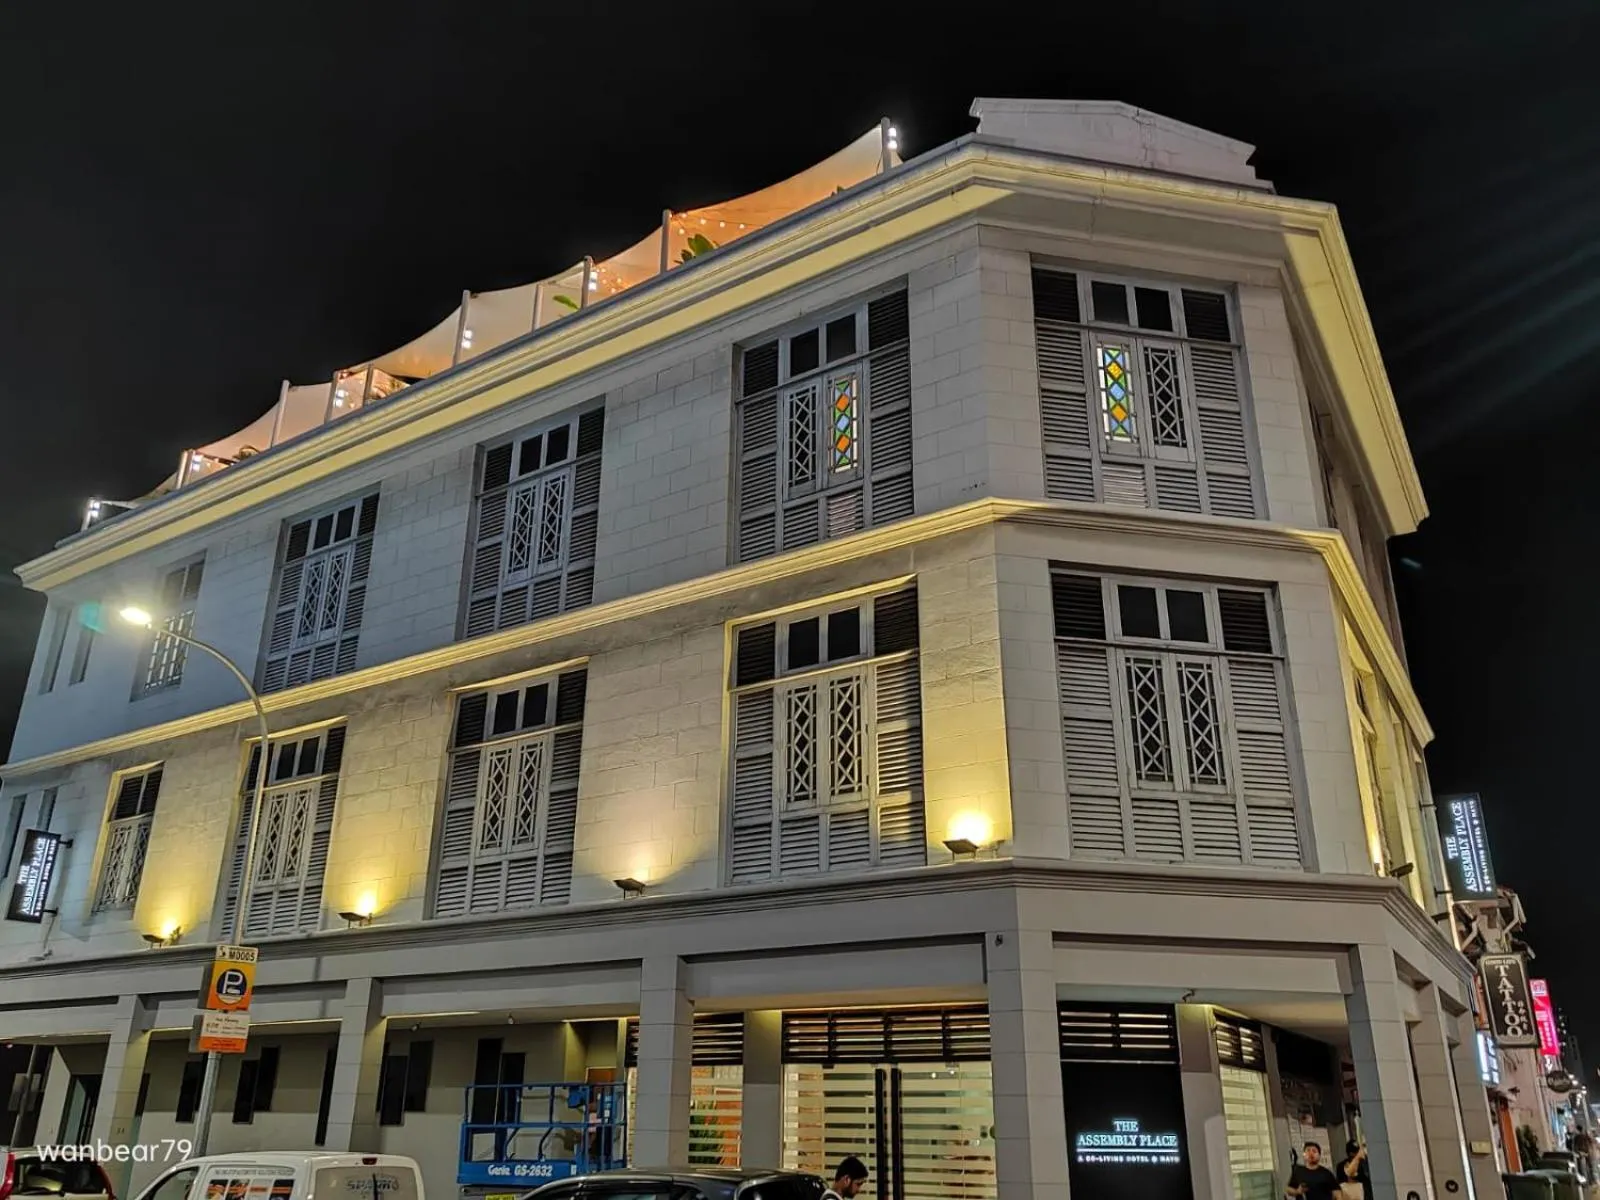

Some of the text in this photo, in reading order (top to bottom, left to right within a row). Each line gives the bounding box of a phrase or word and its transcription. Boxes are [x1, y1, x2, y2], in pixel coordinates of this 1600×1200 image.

[1446, 836, 1459, 859] THE
[1451, 802, 1478, 892] ASSEMBLY PLACE
[18, 865, 30, 884] THE
[20, 837, 46, 915] ASSEMBLY PLACE
[1495, 964, 1523, 1037] TATTOO
[1113, 1120, 1139, 1132] THE
[1078, 1134, 1177, 1147] ASSEMBLY PLACE
[487, 1164, 512, 1176] Genie
